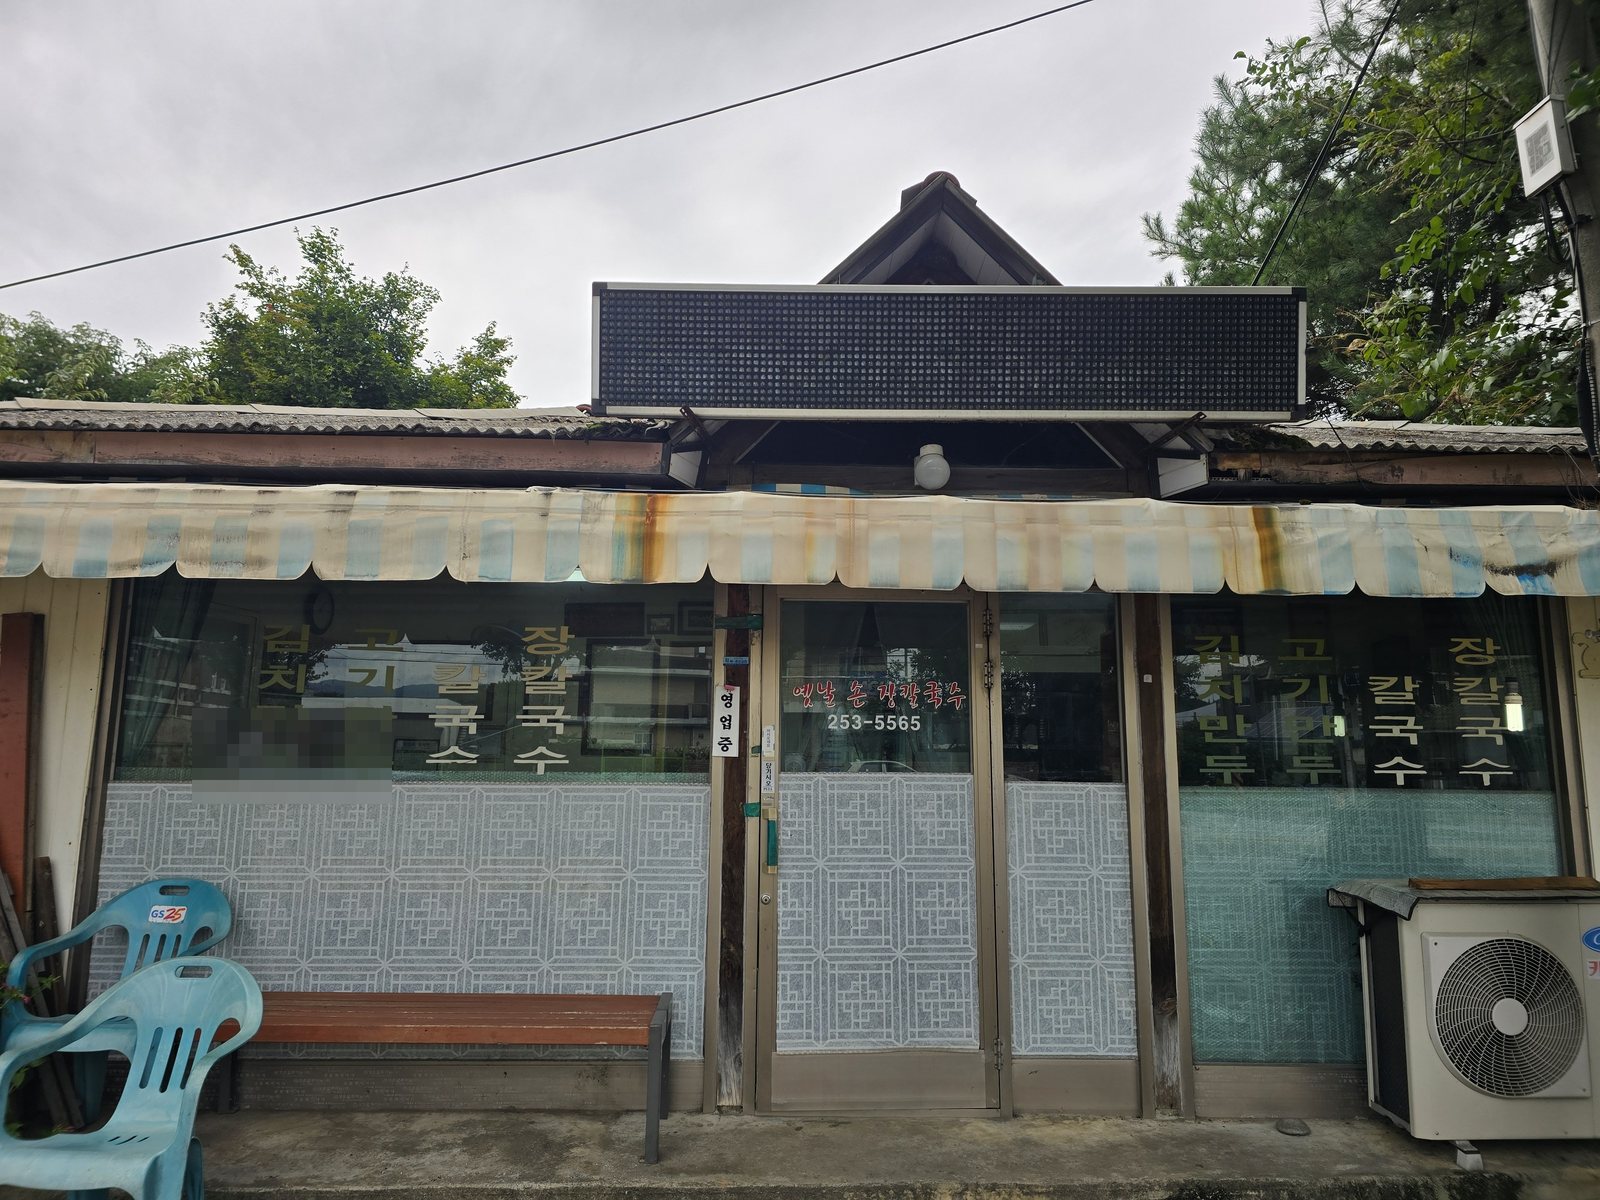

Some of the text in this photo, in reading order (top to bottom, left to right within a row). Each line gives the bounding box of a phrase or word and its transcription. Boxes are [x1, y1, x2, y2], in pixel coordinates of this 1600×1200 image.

[512, 625, 576, 776] 장칼국수
[717, 692, 734, 753] 영업중
[793, 680, 966, 710] 옛날 손 장칼국수
[828, 715, 921, 731] 253-5565
[1192, 635, 1255, 784] 김치만두
[1278, 637, 1342, 785] 고기만두
[1368, 674, 1428, 786] 칼국수
[1448, 636, 1514, 787] 장칼국수
[151, 907, 185, 921] GS25
